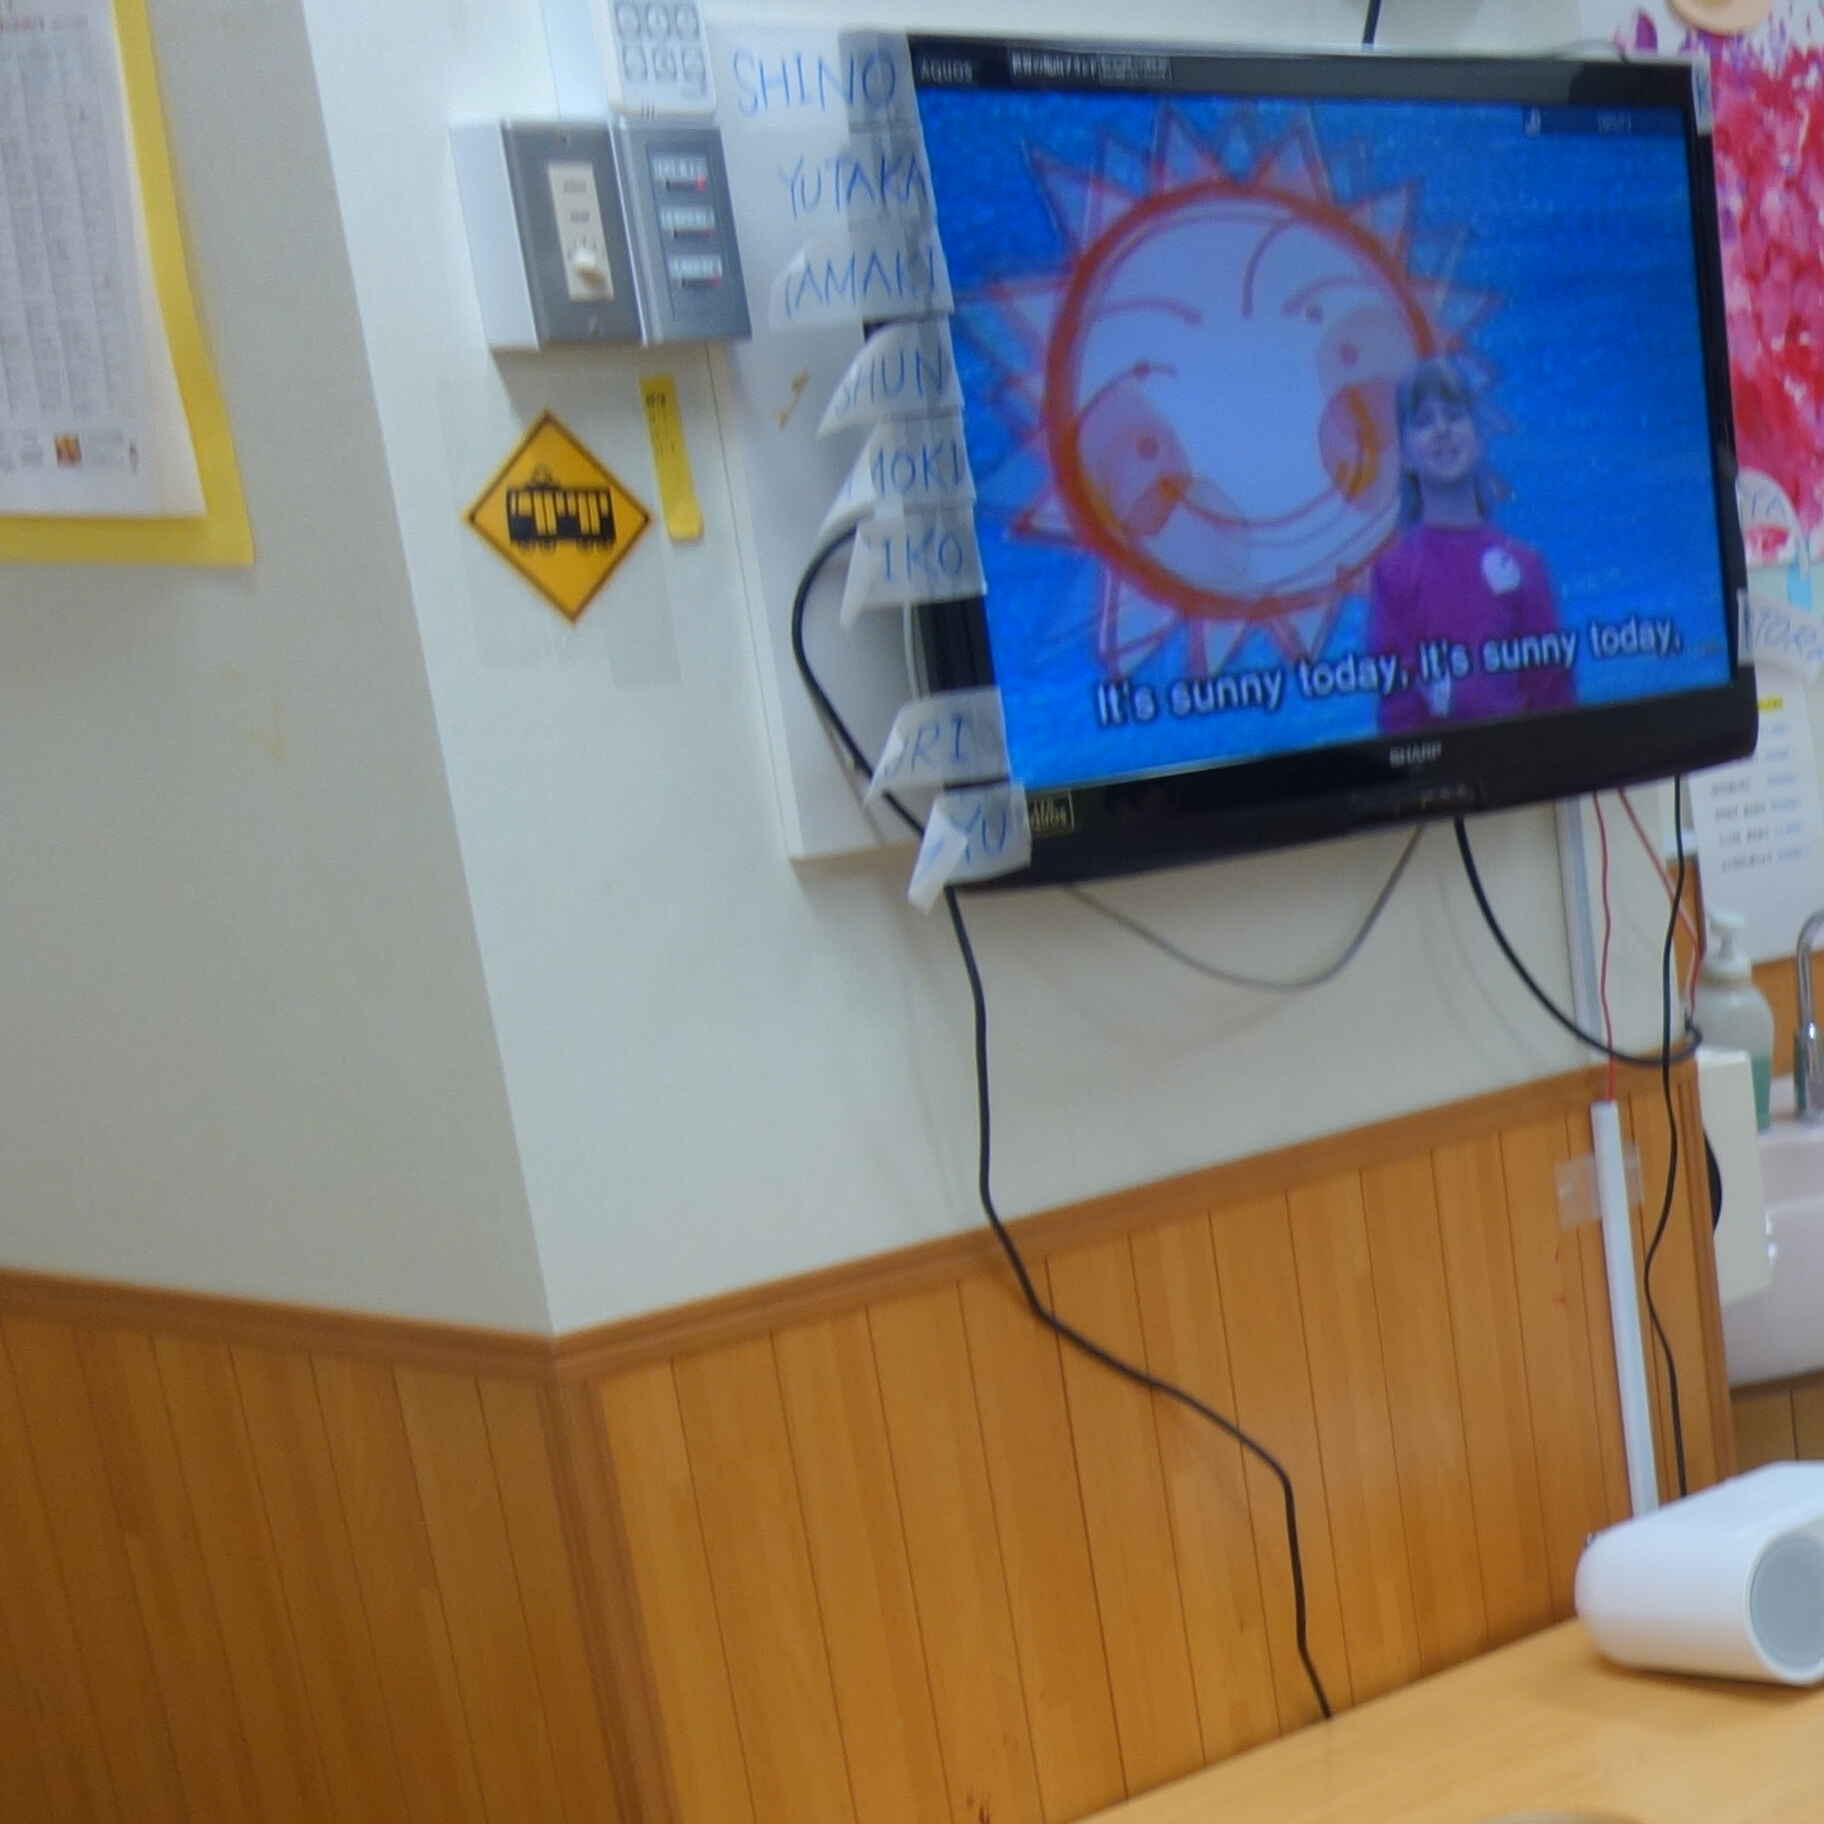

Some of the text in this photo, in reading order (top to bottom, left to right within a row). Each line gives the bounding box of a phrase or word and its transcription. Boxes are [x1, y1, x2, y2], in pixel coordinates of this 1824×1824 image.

[732, 48, 897, 118] SHINO
[776, 148, 928, 223] YUTAKA
[1097, 680, 1155, 726] It's
[1170, 669, 1283, 717] sunny
[1483, 631, 1577, 673] sunny
